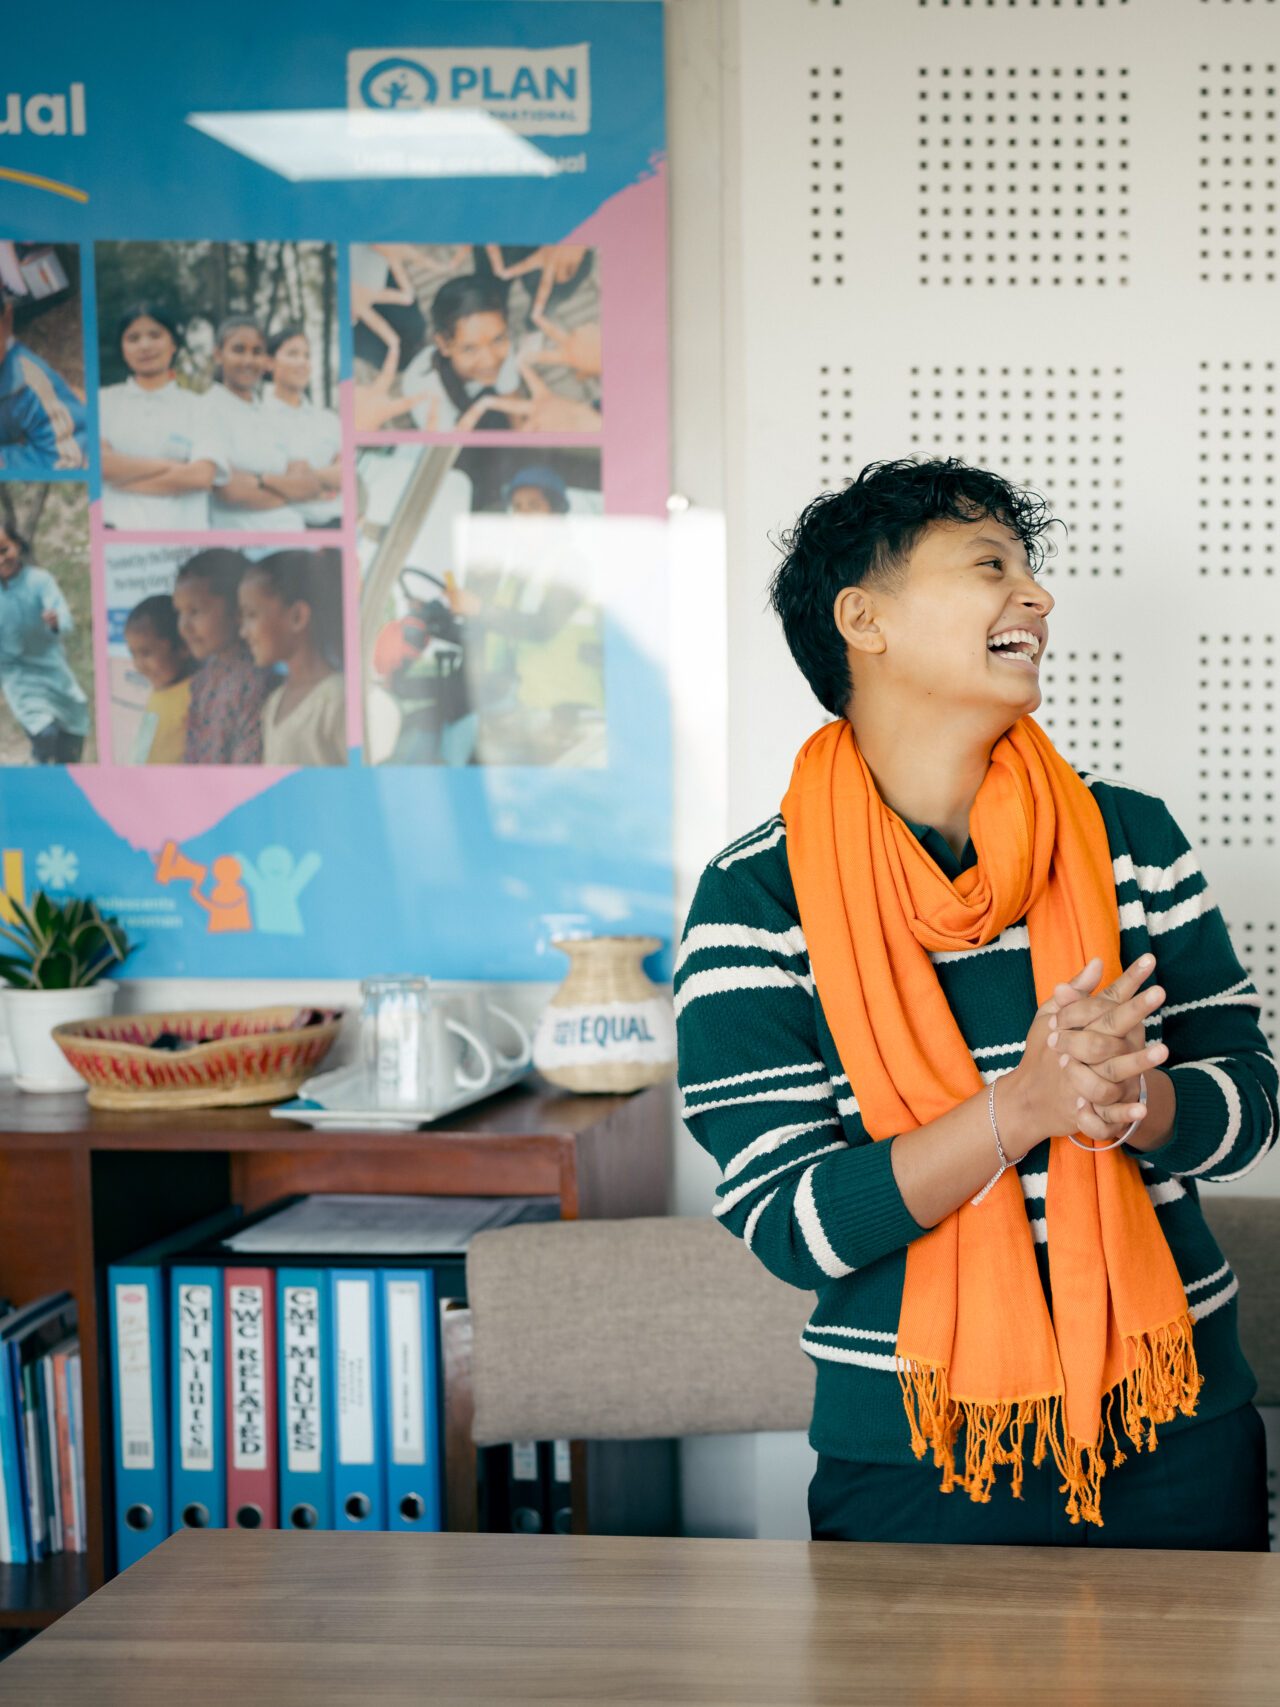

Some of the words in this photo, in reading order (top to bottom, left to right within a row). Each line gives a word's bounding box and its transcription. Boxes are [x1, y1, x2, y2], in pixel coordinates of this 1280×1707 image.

[0, 82, 86, 136] ual
[449, 66, 577, 101] PLAN
[579, 1014, 656, 1048] EQUAL
[232, 1288, 263, 1340] SWC
[287, 1289, 316, 1337] CMT
[235, 1347, 262, 1455] RELATED
[286, 1345, 317, 1452] MINUTES
